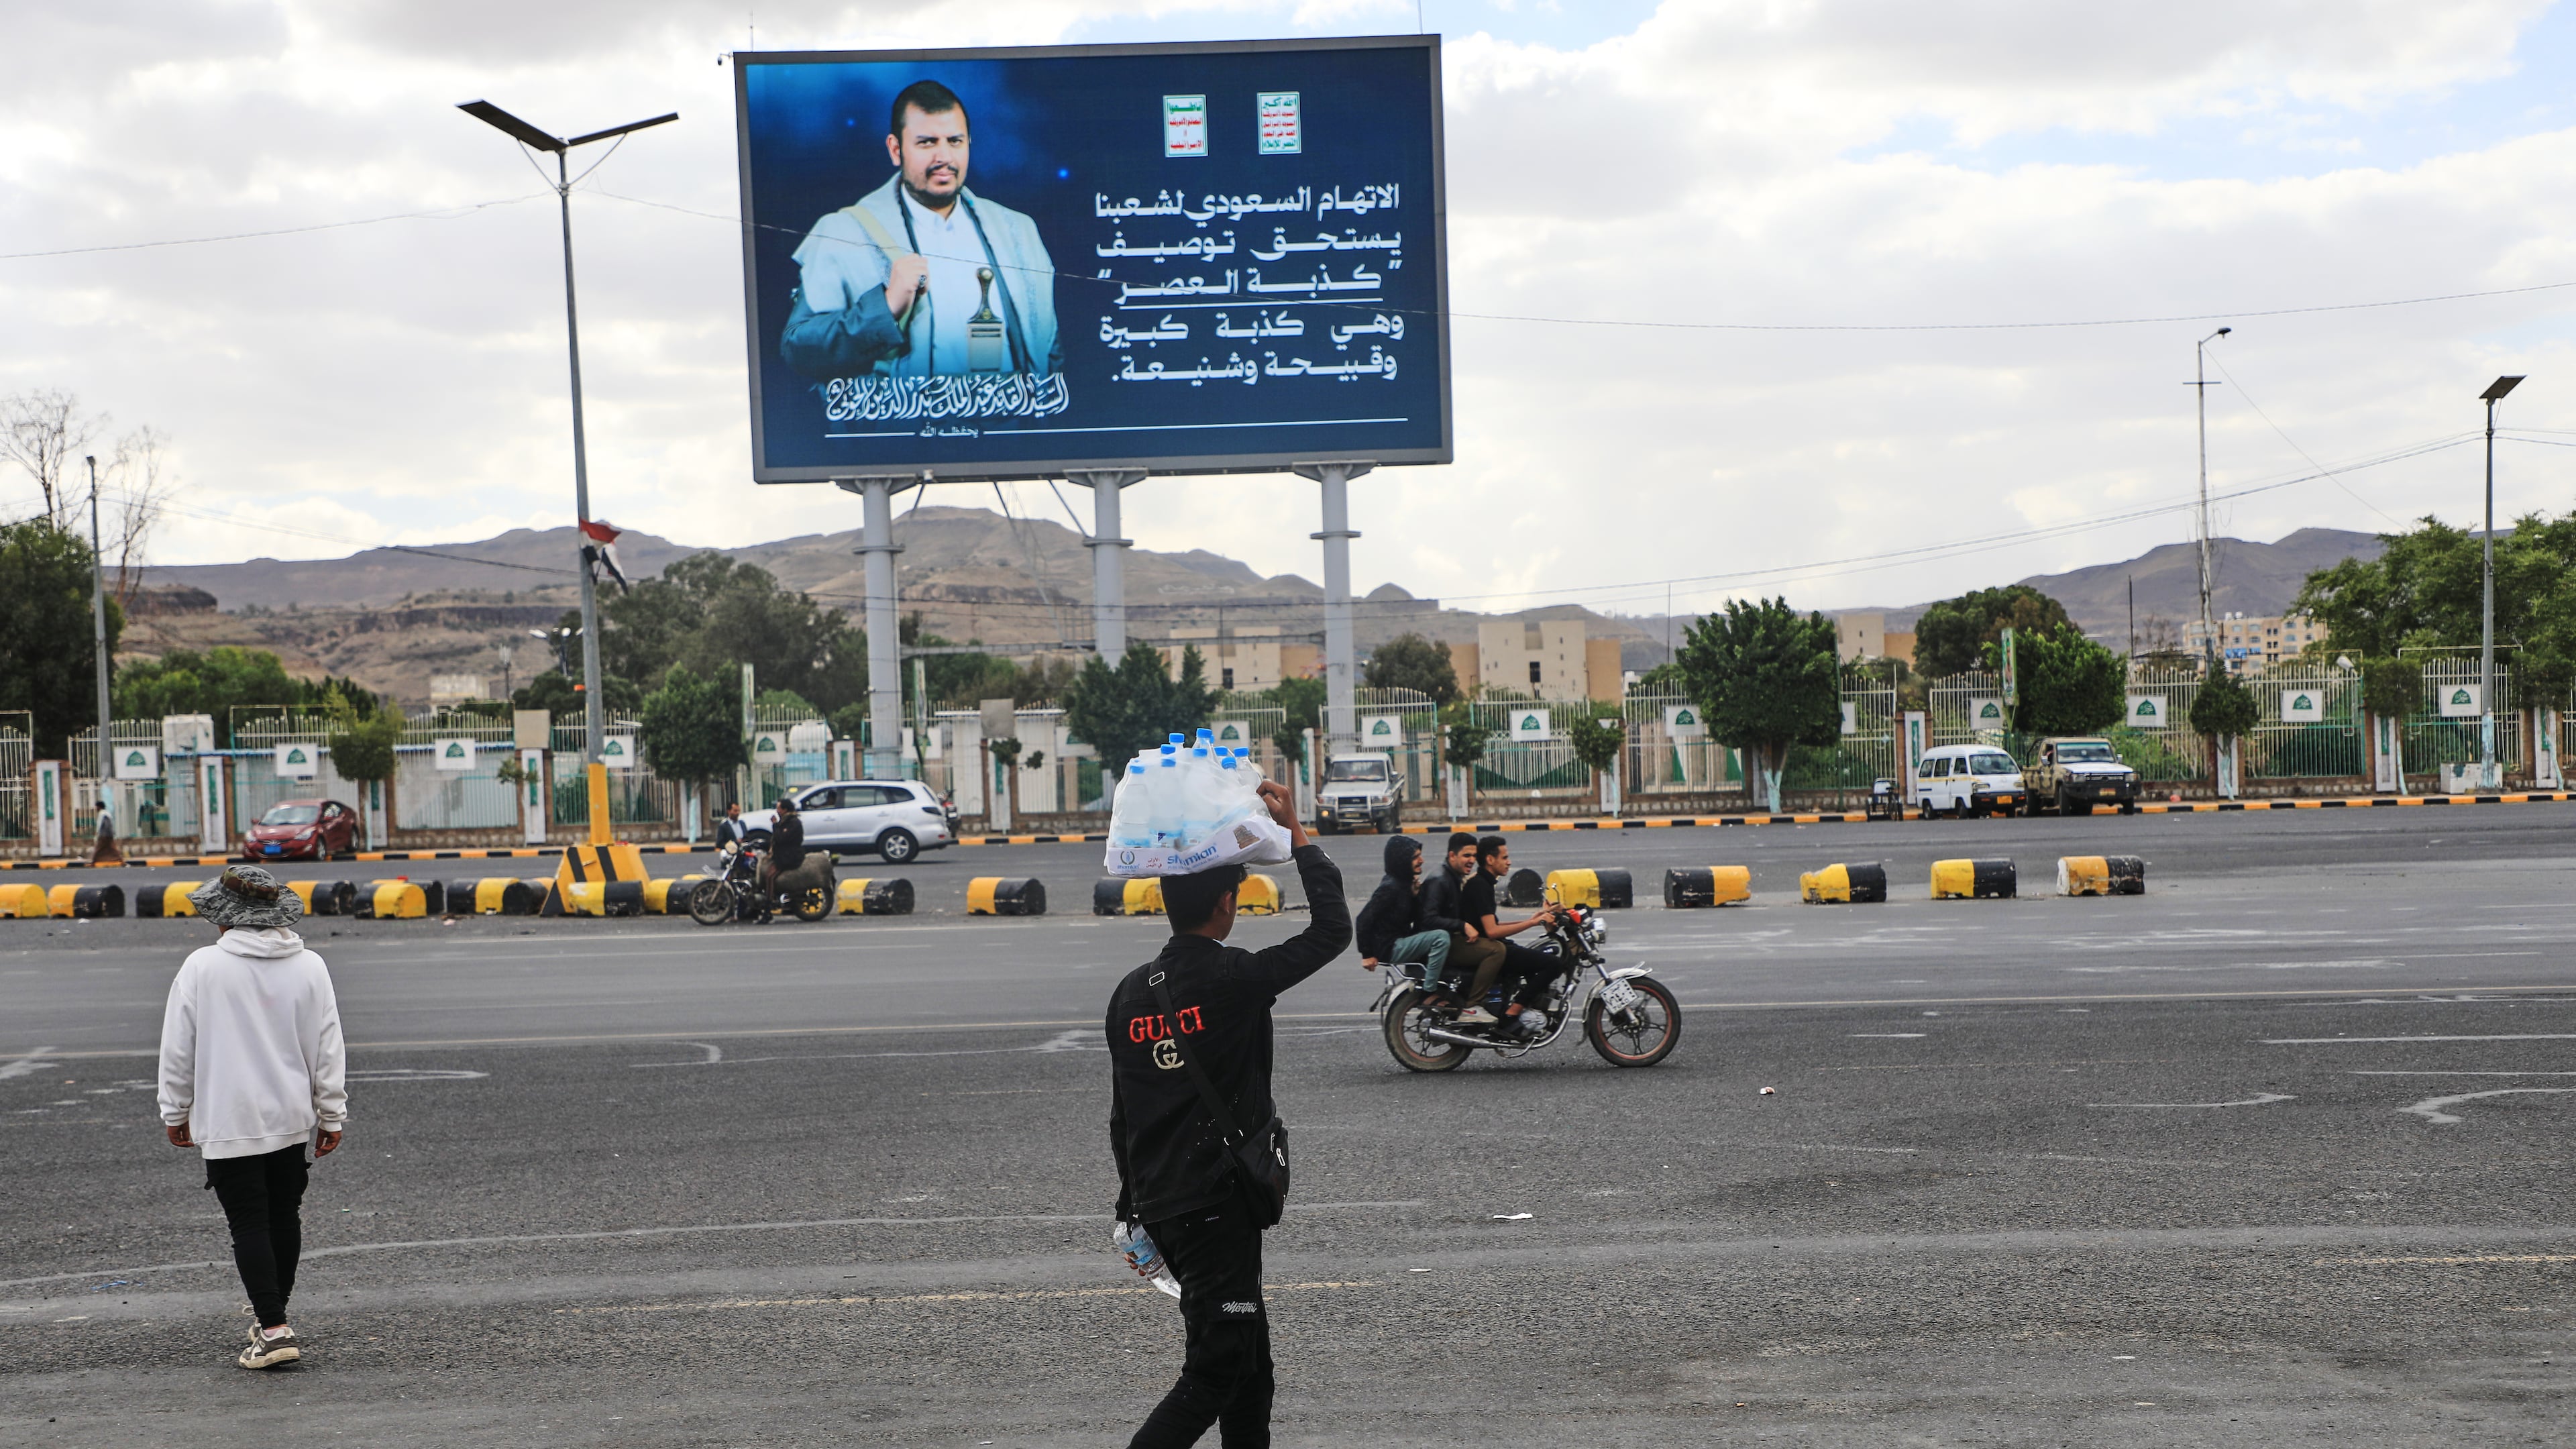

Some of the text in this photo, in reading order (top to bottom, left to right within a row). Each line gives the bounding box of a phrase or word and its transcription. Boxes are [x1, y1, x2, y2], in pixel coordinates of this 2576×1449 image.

[1095, 182, 1399, 228] الاتهام السعودي لشعبنا
[1096, 227, 1402, 263] يستحق توصيف
[1099, 310, 1405, 351] وهي كذبة كبيرة
[1111, 344, 1397, 386] وقبيحة وشنيعة.
